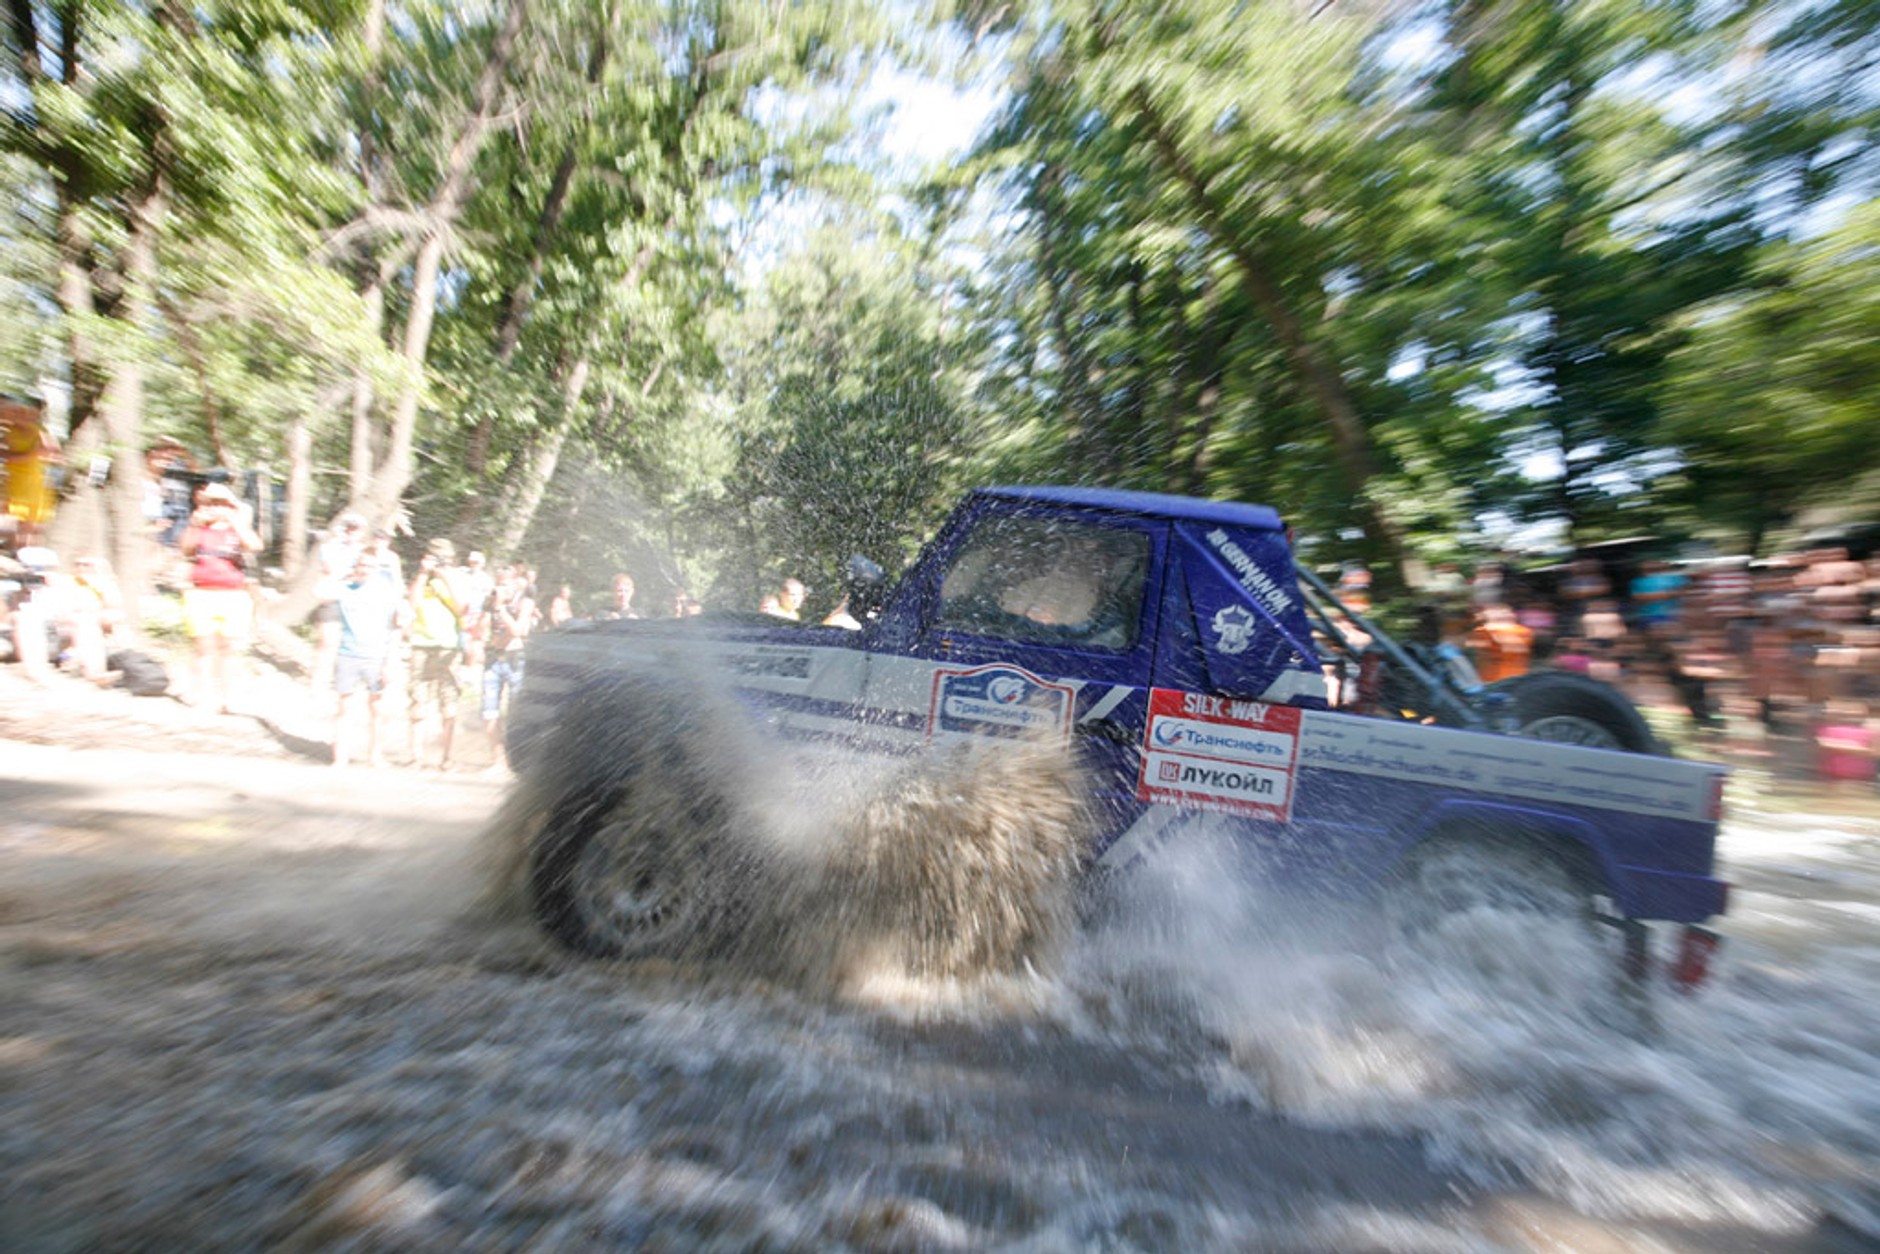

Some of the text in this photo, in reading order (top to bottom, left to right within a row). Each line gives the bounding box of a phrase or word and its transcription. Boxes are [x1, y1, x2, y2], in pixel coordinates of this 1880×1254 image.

[1220, 541, 1276, 596] GERMAN
[1184, 693, 1269, 722] SILK WAY
[1186, 729, 1284, 755] Транснефть
[1181, 767, 1274, 795] ЛУКОЙЛ
